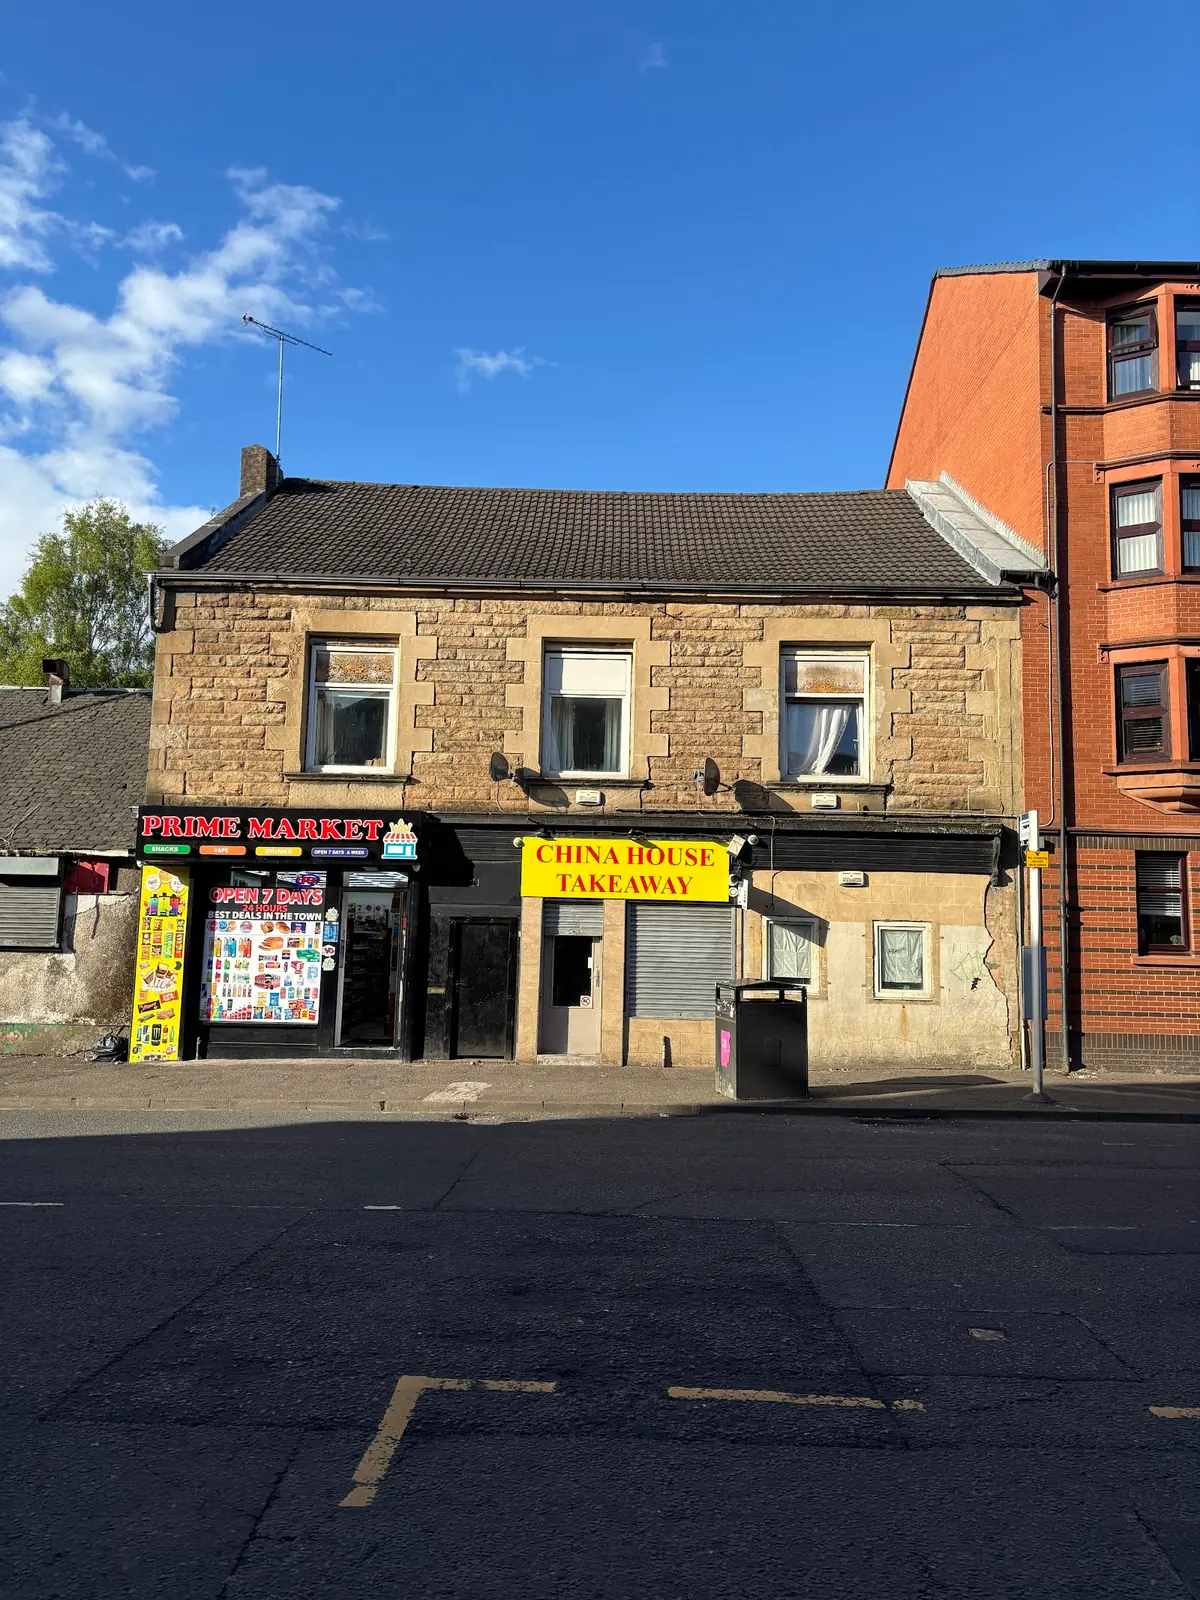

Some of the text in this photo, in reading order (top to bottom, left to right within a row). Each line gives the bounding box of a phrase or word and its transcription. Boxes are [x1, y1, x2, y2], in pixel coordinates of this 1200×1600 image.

[142, 815, 383, 841] PRIME MARKET
[536, 844, 715, 867] CHINA HOUSE
[556, 873, 693, 895] TAKEAWAY
[209, 887, 323, 905] OPEN 7 DAYS
[208, 911, 322, 921] BEST DEALS IN THE TOWN
[242, 904, 254, 912] 24
